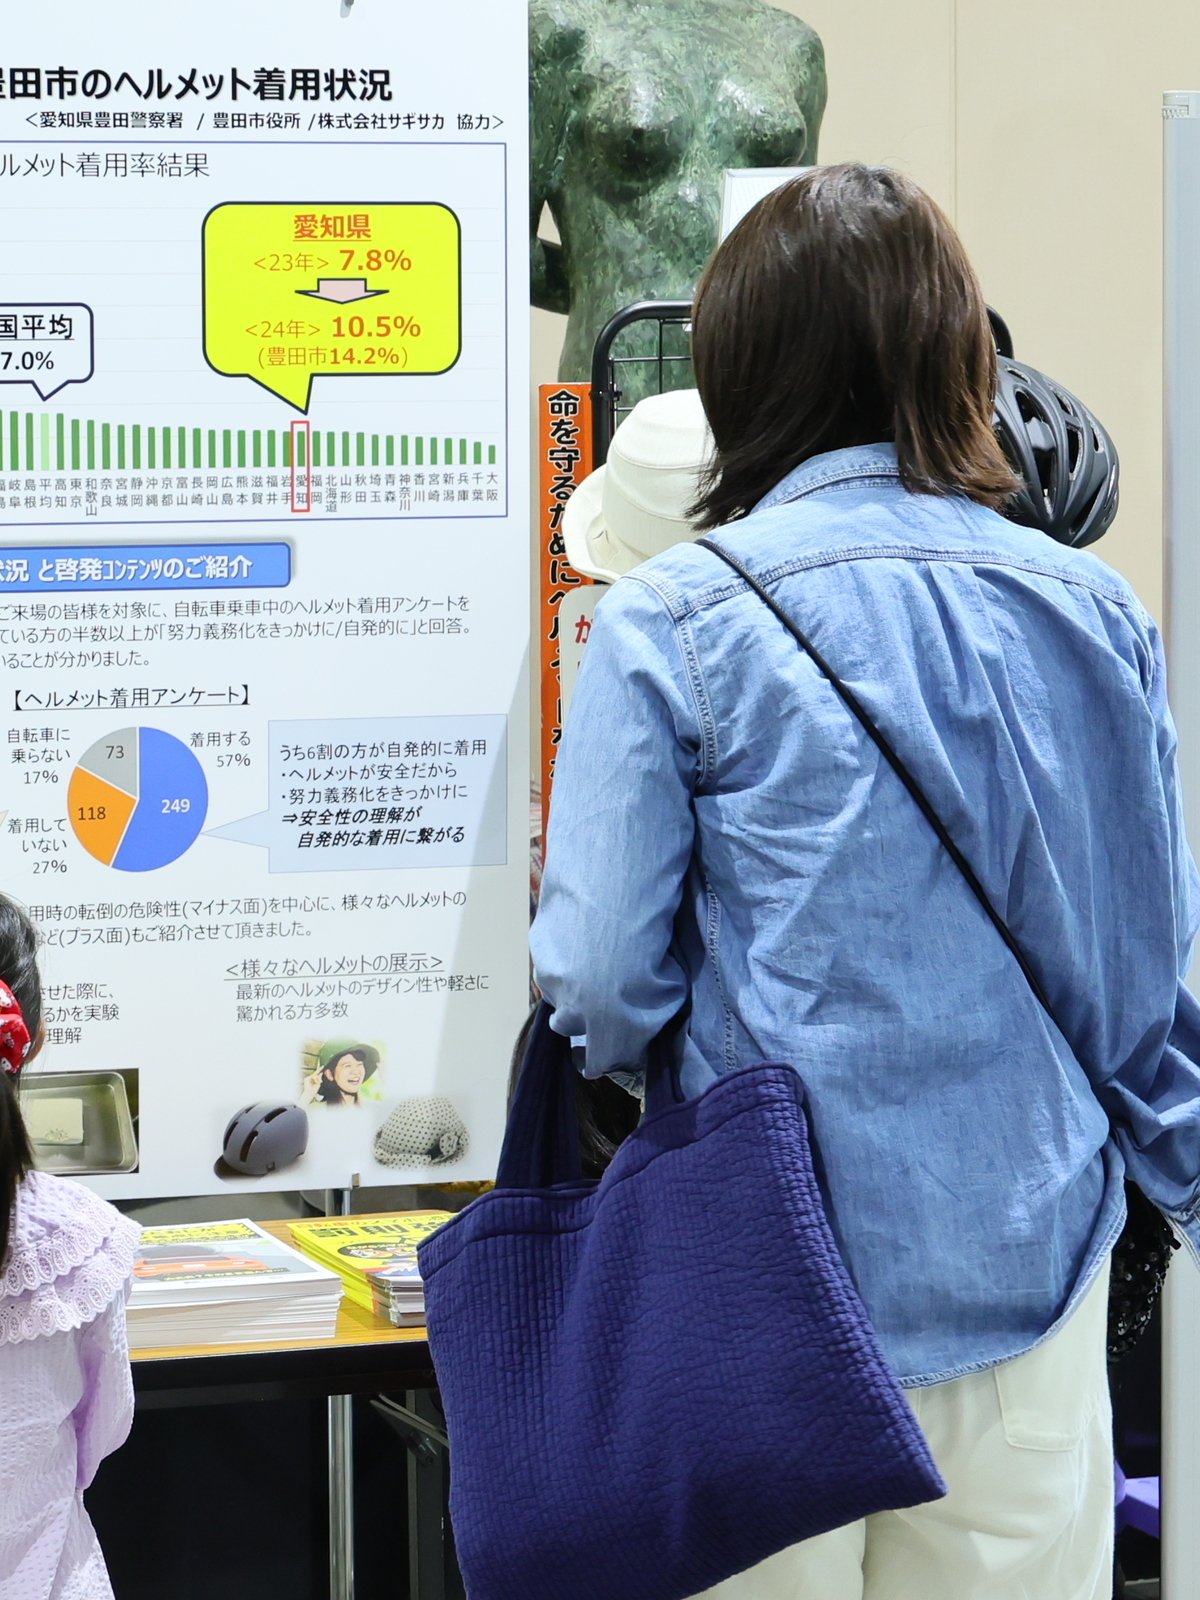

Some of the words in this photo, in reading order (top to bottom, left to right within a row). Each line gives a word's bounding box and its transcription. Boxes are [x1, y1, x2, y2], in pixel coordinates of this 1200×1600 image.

[213, 112, 301, 130] 豊田市役所
[294, 213, 372, 239] 愛知県
[339, 249, 412, 272] 7.8%
[332, 316, 421, 338] 10.5%
[39, 480, 51, 508] 平均
[55, 478, 67, 508] 高知
[70, 478, 82, 508] 東京
[85, 478, 98, 516] 和歌山
[101, 478, 113, 508] 奈良
[161, 477, 174, 506] 京都
[176, 476, 188, 506] 富山
[221, 476, 233, 506] 広島
[266, 475, 278, 505] 福井
[296, 474, 308, 504] 愛知
[326, 474, 338, 513] 北海道
[340, 474, 352, 503] 山形
[355, 474, 367, 503] 秋田
[384, 474, 397, 502] 青森
[399, 473, 411, 511] 神奈川
[414, 473, 426, 502] 香川
[428, 473, 440, 502] 宮崎
[472, 472, 484, 501] 千葉
[486, 472, 499, 501] 大阪
[13, 684, 250, 711] 【ヘルメット着用アンケート】
[7, 728, 70, 744] 自転車に
[190, 731, 251, 747] 着用する
[280, 739, 487, 761] うち6割の方が自発的に着用
[11, 746, 70, 764] 乗らない
[105, 745, 124, 759] 73
[216, 753, 251, 768] 57%
[23, 770, 58, 785] 17%
[77, 806, 106, 821] 118
[161, 798, 190, 813] 249
[7, 817, 67, 834] 着用して
[298, 826, 465, 849] 自発的な着用に繋がる
[21, 837, 67, 853] いない
[32, 859, 67, 874] 27%
[236, 973, 489, 1001] 最新のヘルメットのデザイン性や軽さに
[236, 1002, 349, 1023] 驚かれる方多数
